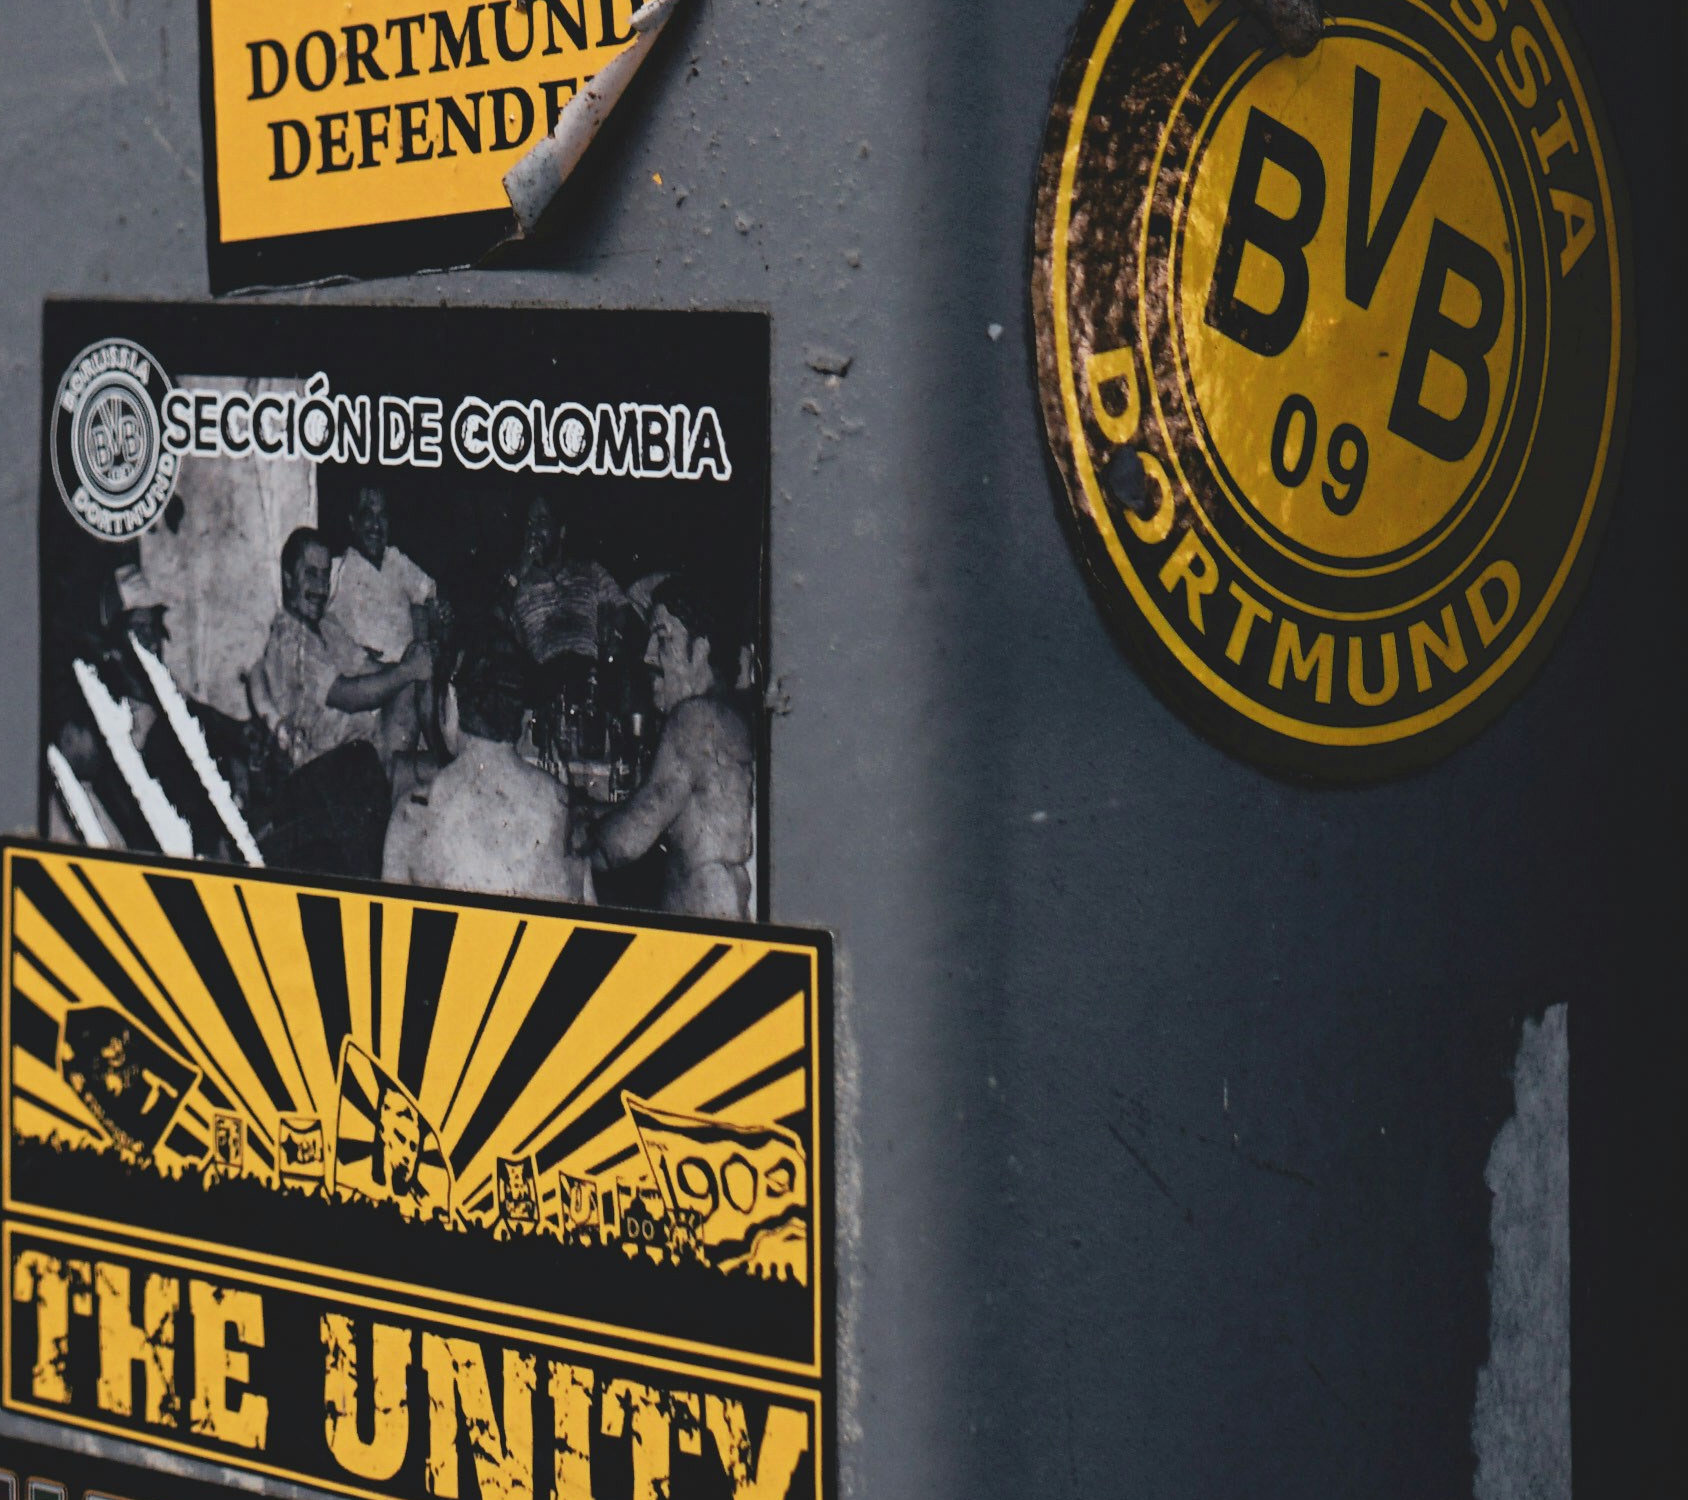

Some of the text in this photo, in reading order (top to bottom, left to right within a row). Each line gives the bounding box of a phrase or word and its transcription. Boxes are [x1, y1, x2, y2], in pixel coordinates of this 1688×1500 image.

[1205, 67, 1504, 463] BVB
[160, 371, 731, 481] SECCIÓN DE COLOMBIA
[1273, 395, 1369, 515] 09
[10, 1247, 270, 1452] THE
